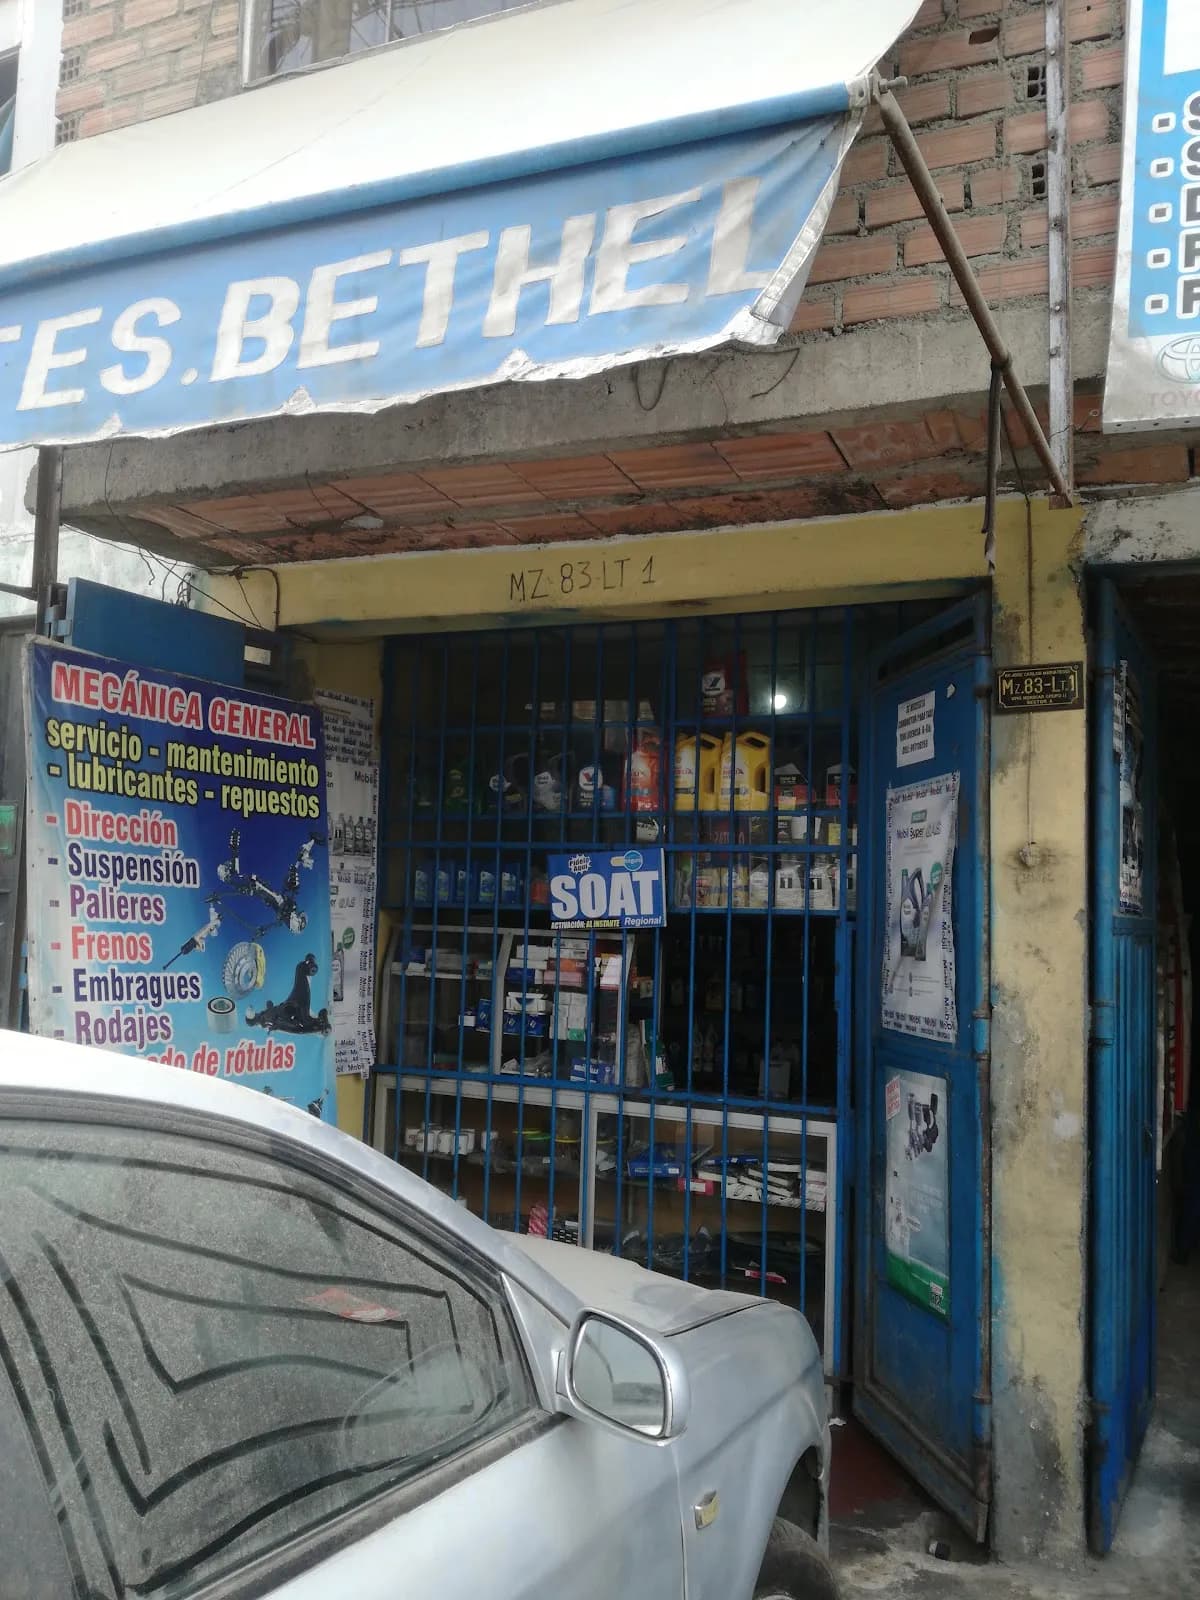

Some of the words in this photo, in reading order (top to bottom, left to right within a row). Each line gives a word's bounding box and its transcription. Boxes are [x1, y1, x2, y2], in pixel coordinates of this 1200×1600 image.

[642, 555, 655, 584] 1
[52, 662, 203, 729] MECÁNICA
[210, 697, 316, 748] GENERAL
[47, 719, 142, 762] servicio
[167, 740, 320, 788] mantenimiento
[67, 752, 198, 805] lubricantes
[221, 783, 320, 818] repuestos
[66, 801, 177, 847] Dirección
[68, 843, 199, 887] Suspensión
[70, 884, 165, 922] Palieres
[551, 870, 659, 920] SOAT
[624, 916, 662, 928] Regional
[71, 926, 151, 962] Frenos
[72, 968, 200, 1008] Embragues
[75, 1010, 172, 1049] Rodajes
[224, 1040, 295, 1075] rótulas
